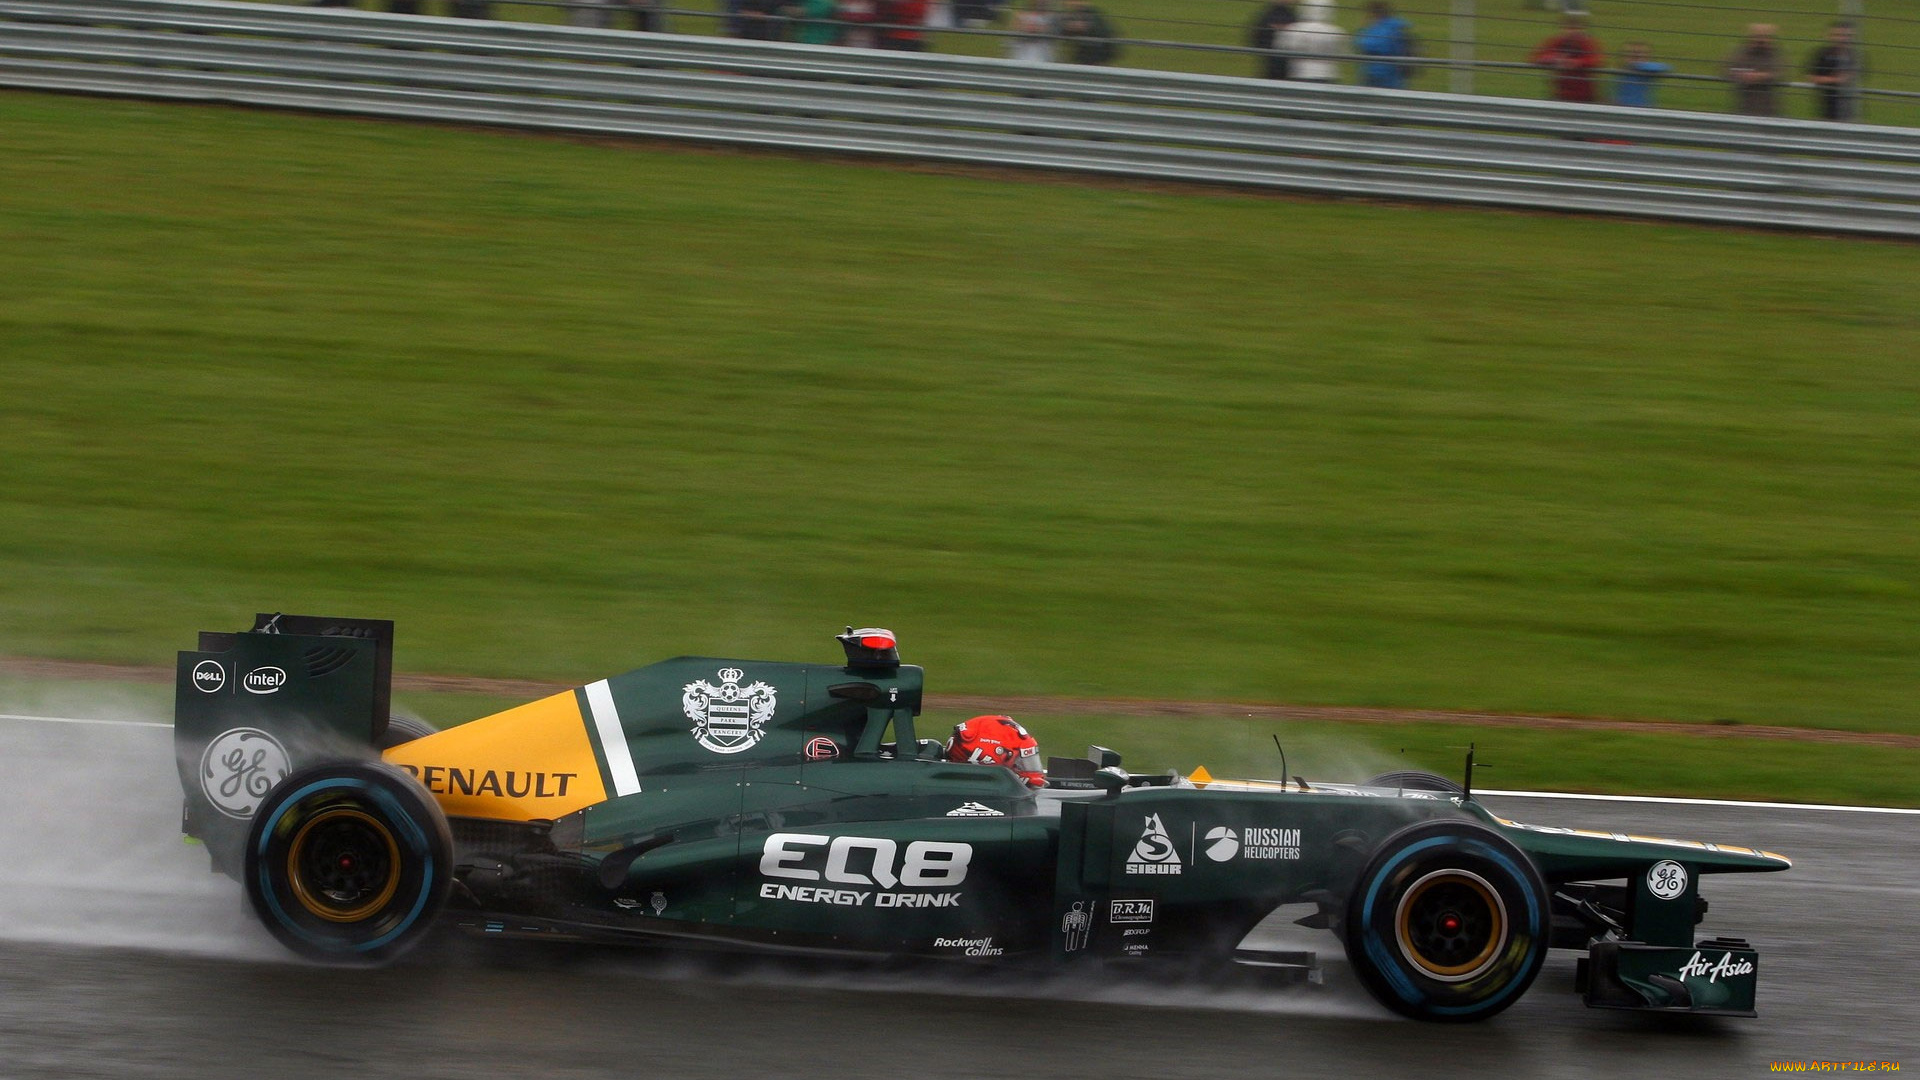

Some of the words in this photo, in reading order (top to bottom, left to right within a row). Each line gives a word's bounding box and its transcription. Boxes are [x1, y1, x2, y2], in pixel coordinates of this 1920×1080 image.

[196, 671, 222, 681] DELL
[249, 672, 279, 686] intel
[1244, 828, 1301, 847] RUSSIAN
[1244, 847, 1300, 860] HELICOPTERS
[759, 833, 973, 890] EQ8
[1125, 863, 1182, 875] SIBUR
[759, 883, 871, 906] ENERGY
[875, 892, 963, 908] DRINK
[933, 936, 992, 948] Rockwell
[965, 944, 1004, 956] Collins
